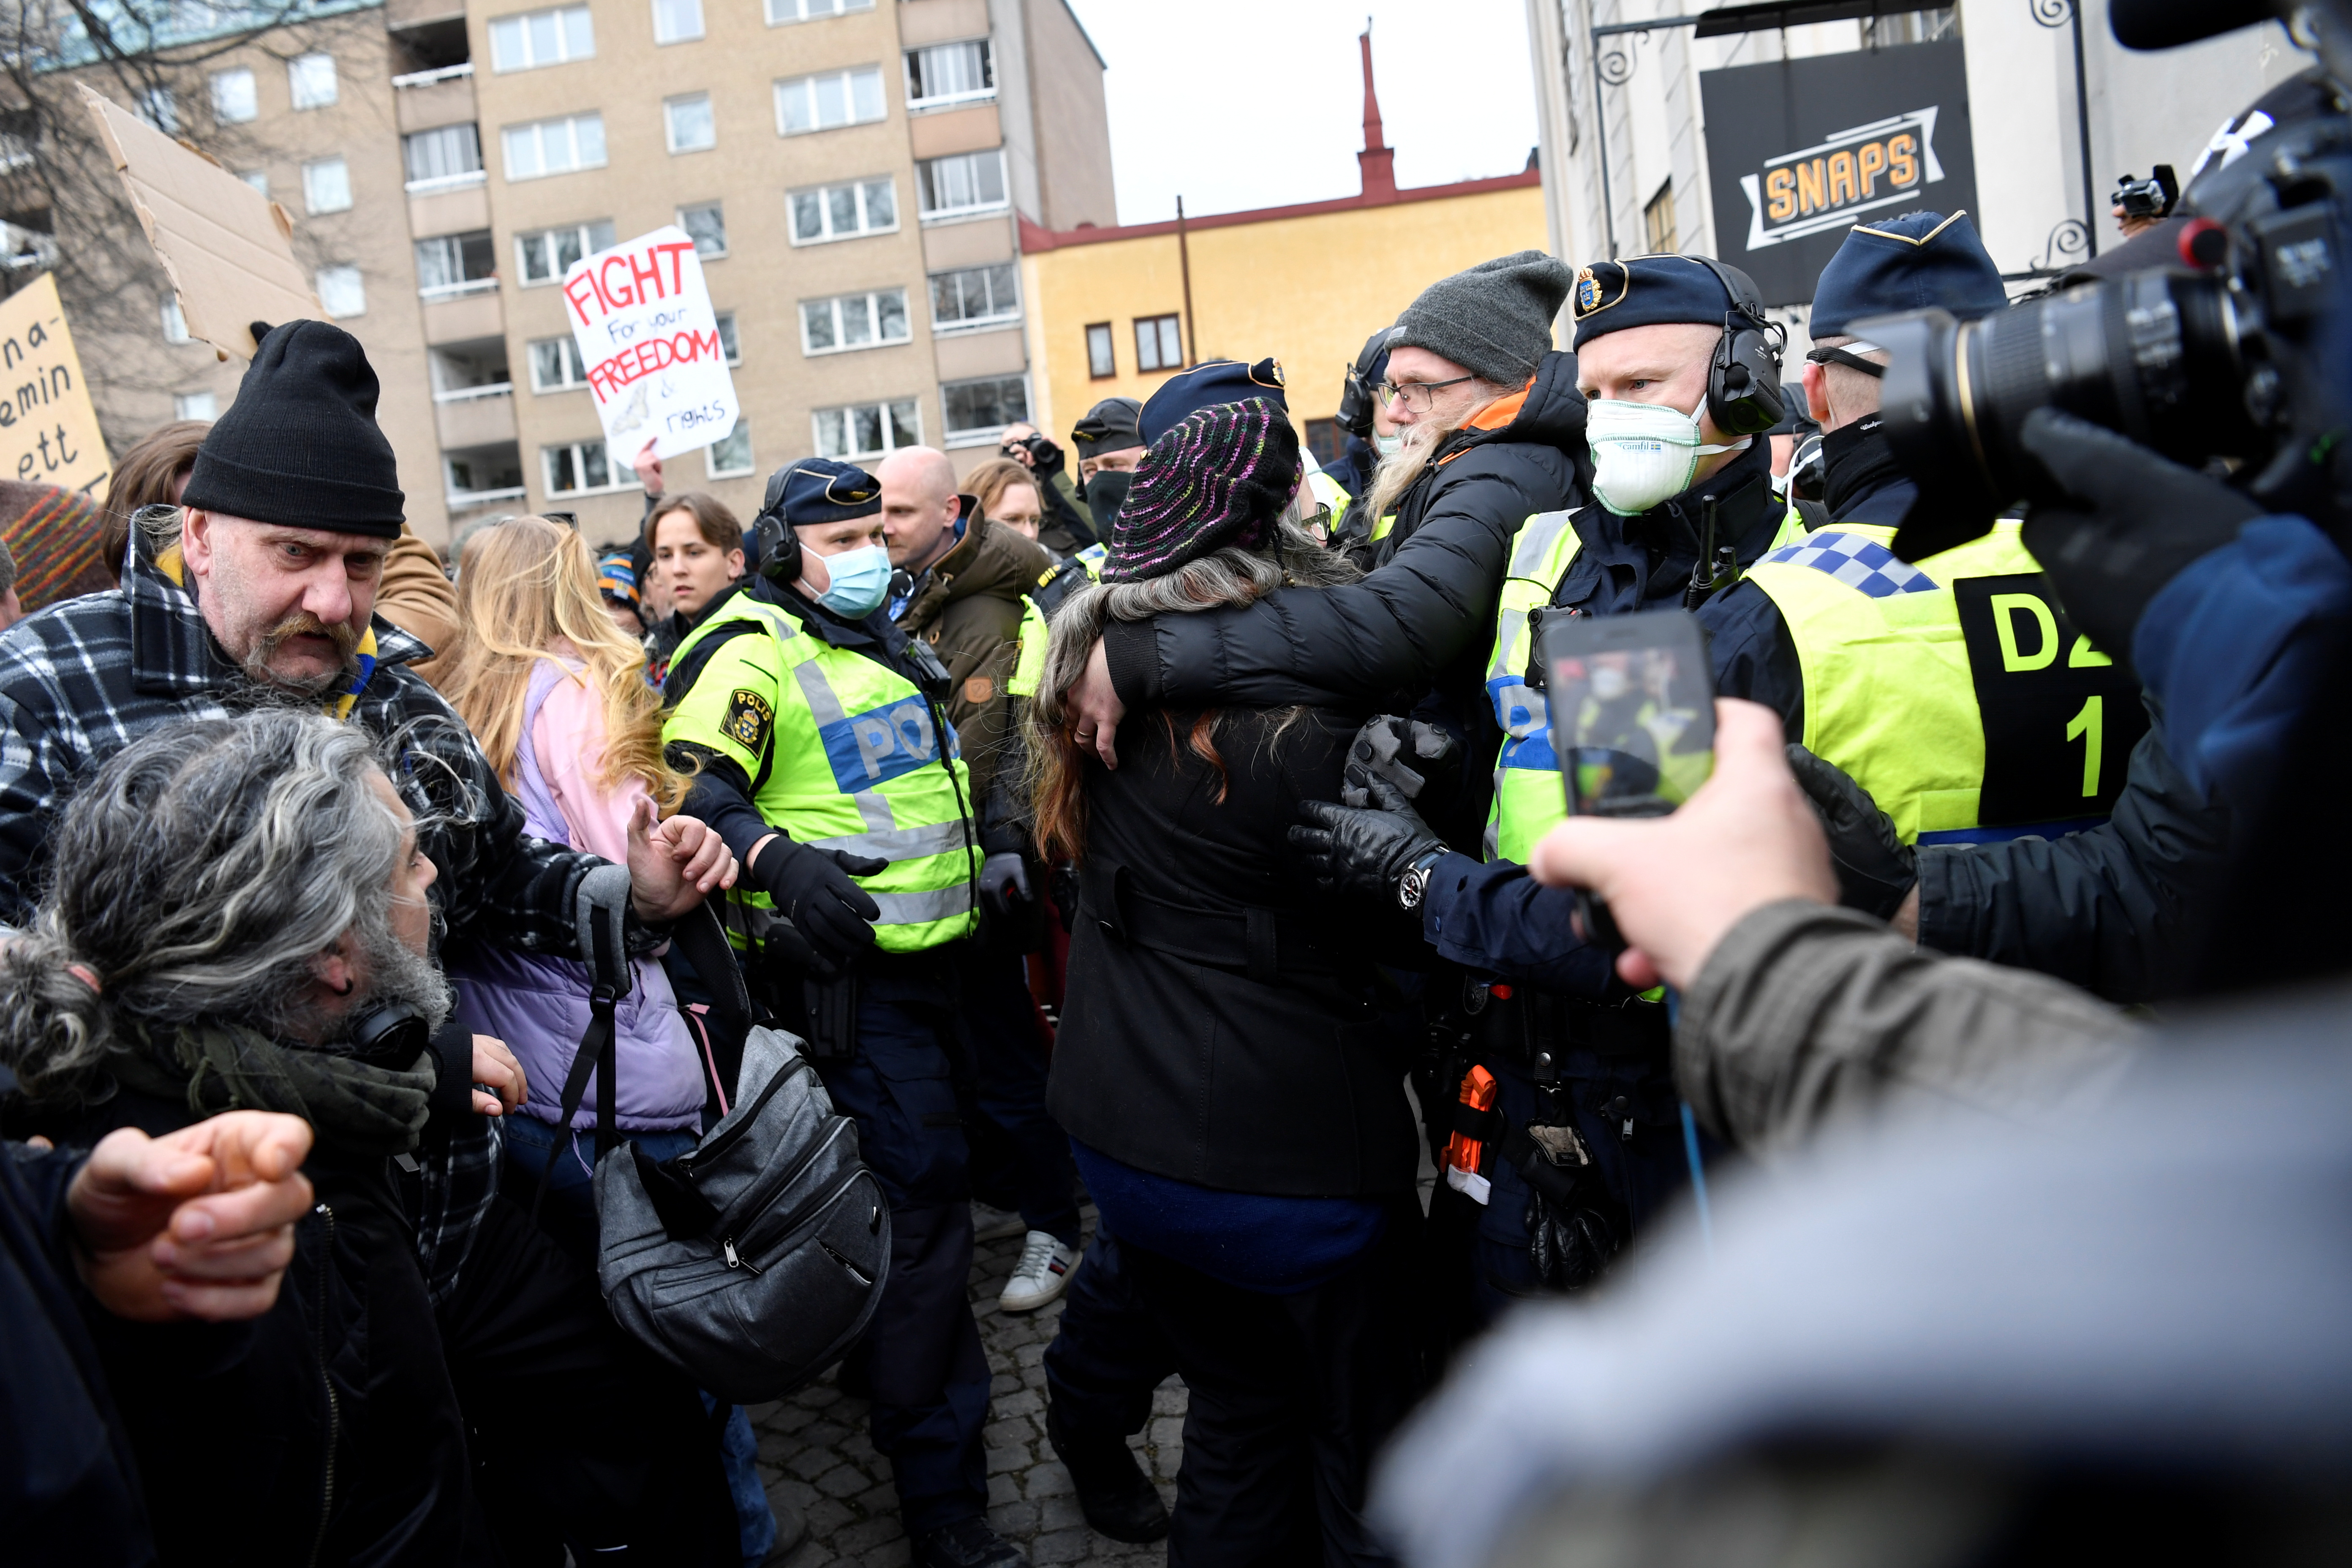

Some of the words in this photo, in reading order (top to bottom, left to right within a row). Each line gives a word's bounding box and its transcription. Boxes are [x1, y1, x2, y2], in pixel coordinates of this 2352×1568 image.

[1766, 134, 1919, 223] SNAPS
[563, 242, 695, 327] FIGHT
[607, 319, 638, 343] For
[648, 309, 687, 334] your
[586, 329, 719, 404] FREEDOM
[667, 400, 725, 433] rights
[1622, 441, 1649, 450] camfil
[737, 693, 770, 721] POLIS
[2066, 695, 2102, 798] 1
